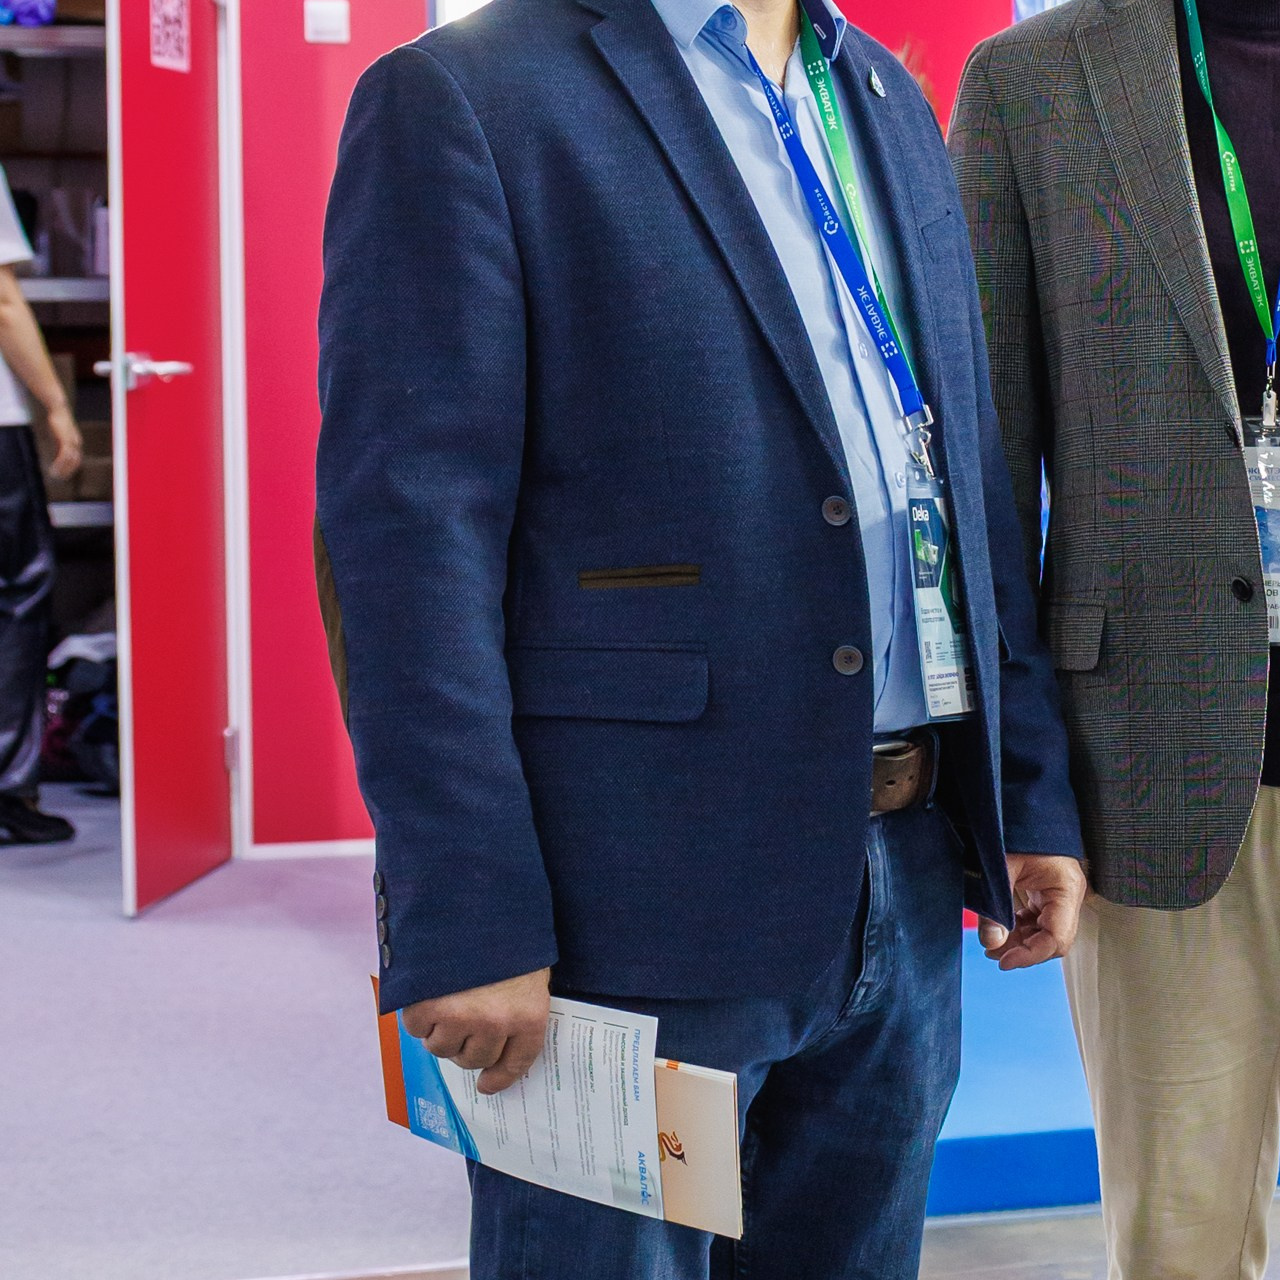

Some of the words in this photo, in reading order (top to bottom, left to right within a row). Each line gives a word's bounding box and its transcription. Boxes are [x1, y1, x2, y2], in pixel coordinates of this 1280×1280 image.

[814, 77, 839, 131] ЭКВАТЭК
[1245, 257, 1264, 308] ЭКВАТЭК
[856, 285, 888, 341] ЭКВАТЭК
[637, 1150, 650, 1206] АКВАЛОС
